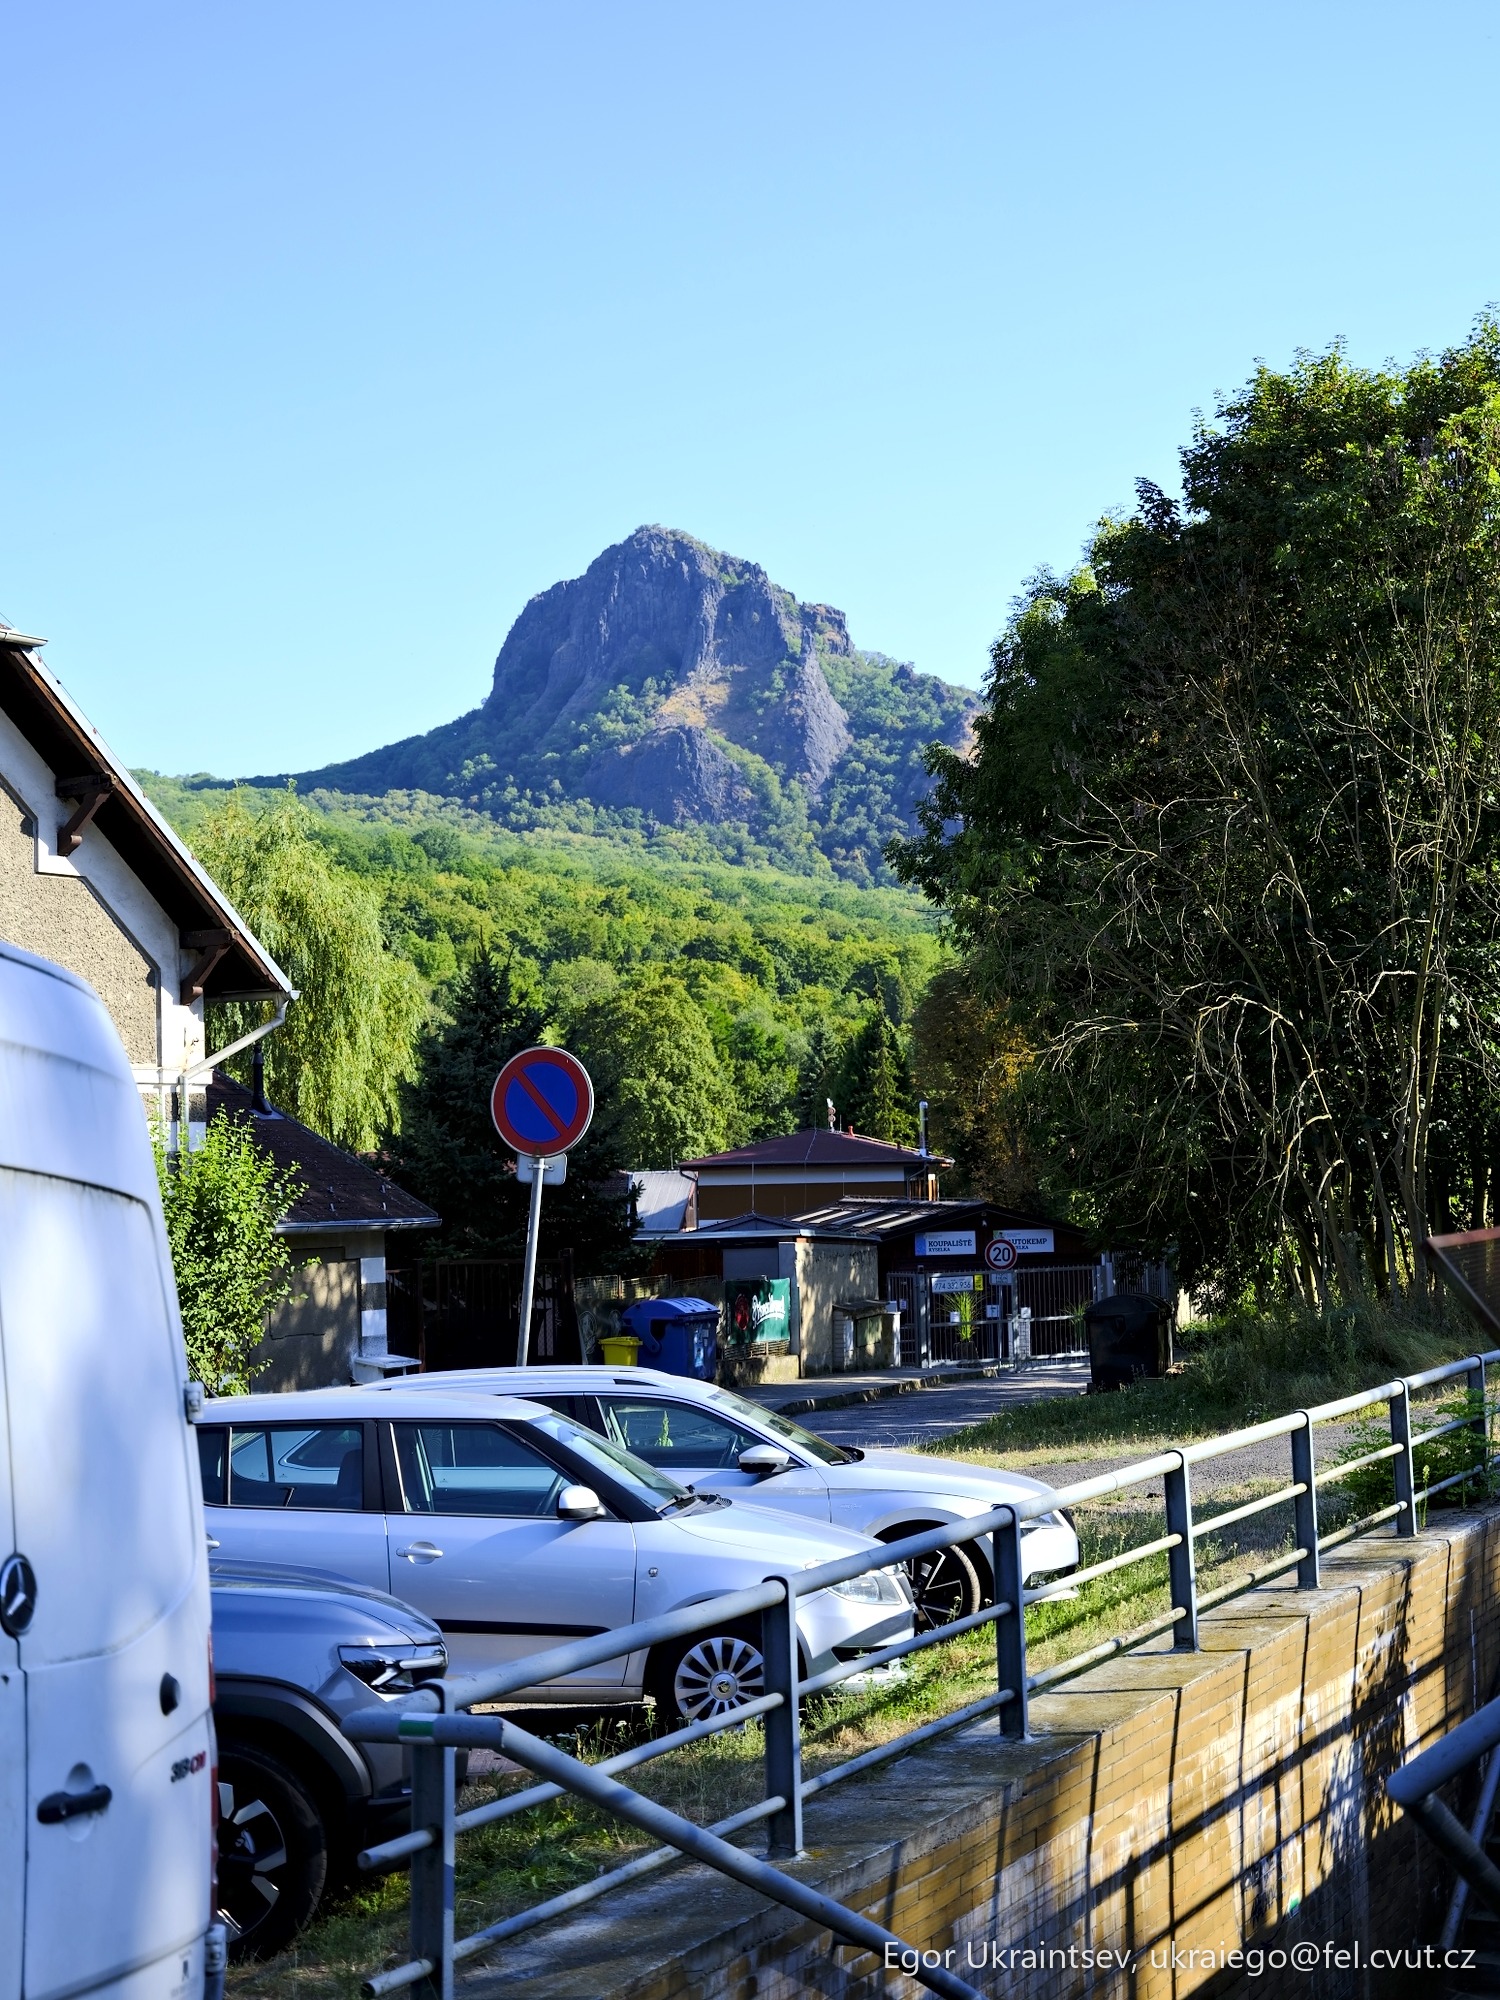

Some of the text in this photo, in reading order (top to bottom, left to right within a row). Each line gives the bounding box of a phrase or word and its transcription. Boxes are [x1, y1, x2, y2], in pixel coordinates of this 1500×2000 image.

[928, 1238, 973, 1248] KOUPALIŠTĚ
[992, 1246, 1011, 1262] 20
[934, 1282, 946, 1291] 774
